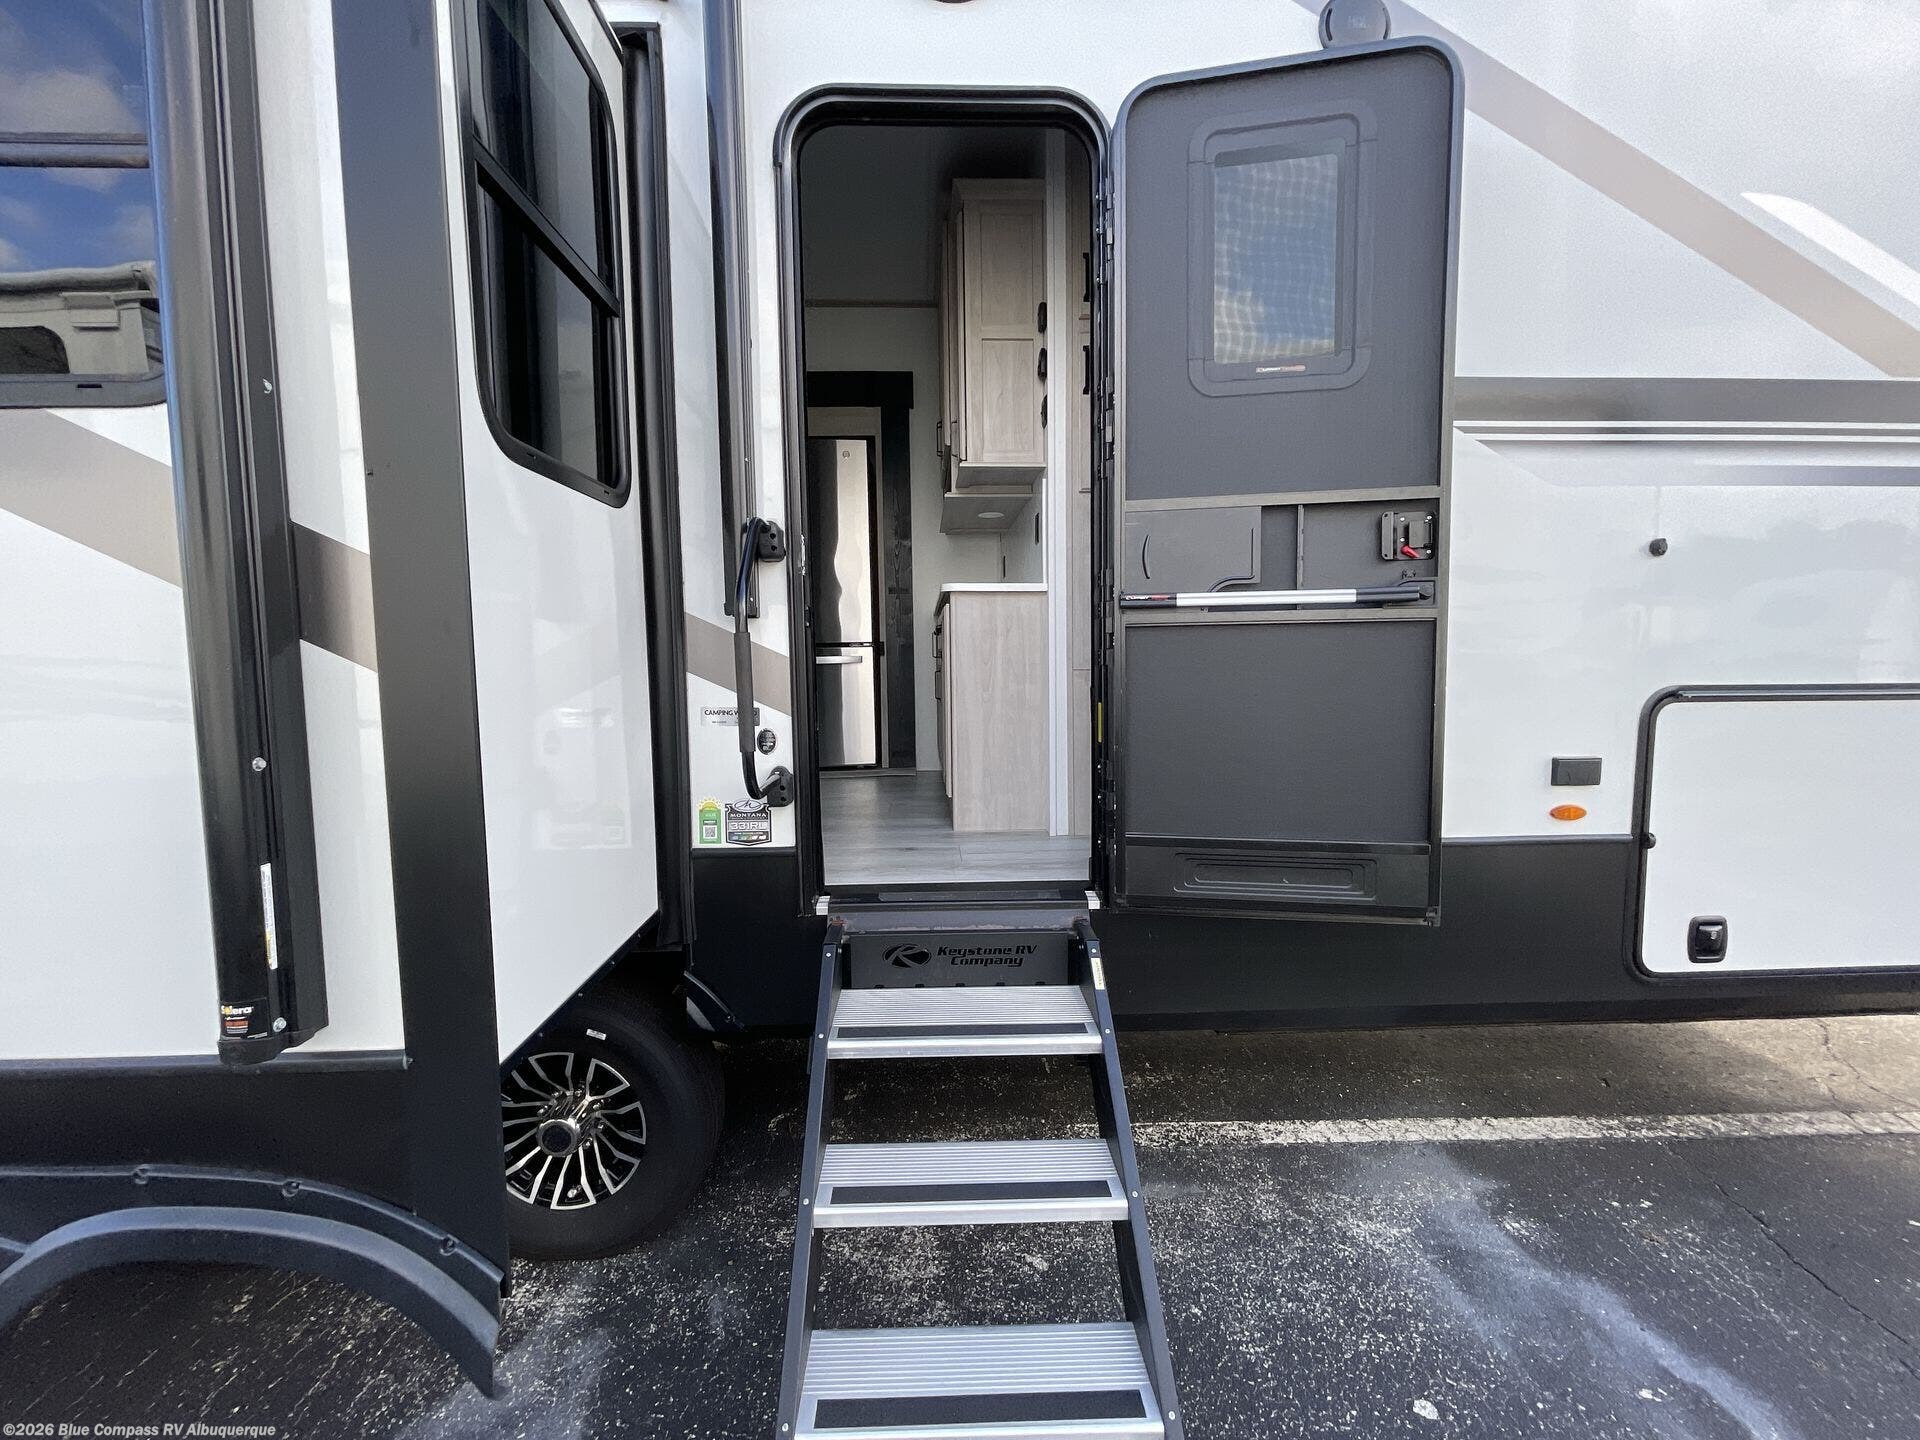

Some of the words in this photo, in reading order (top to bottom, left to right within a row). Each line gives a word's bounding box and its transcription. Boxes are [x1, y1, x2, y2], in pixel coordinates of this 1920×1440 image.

[730, 822, 767, 830] 331RL
[937, 946, 1012, 957] Keystone
[1015, 945, 1037, 954] RV
[950, 957, 1023, 967] Company
